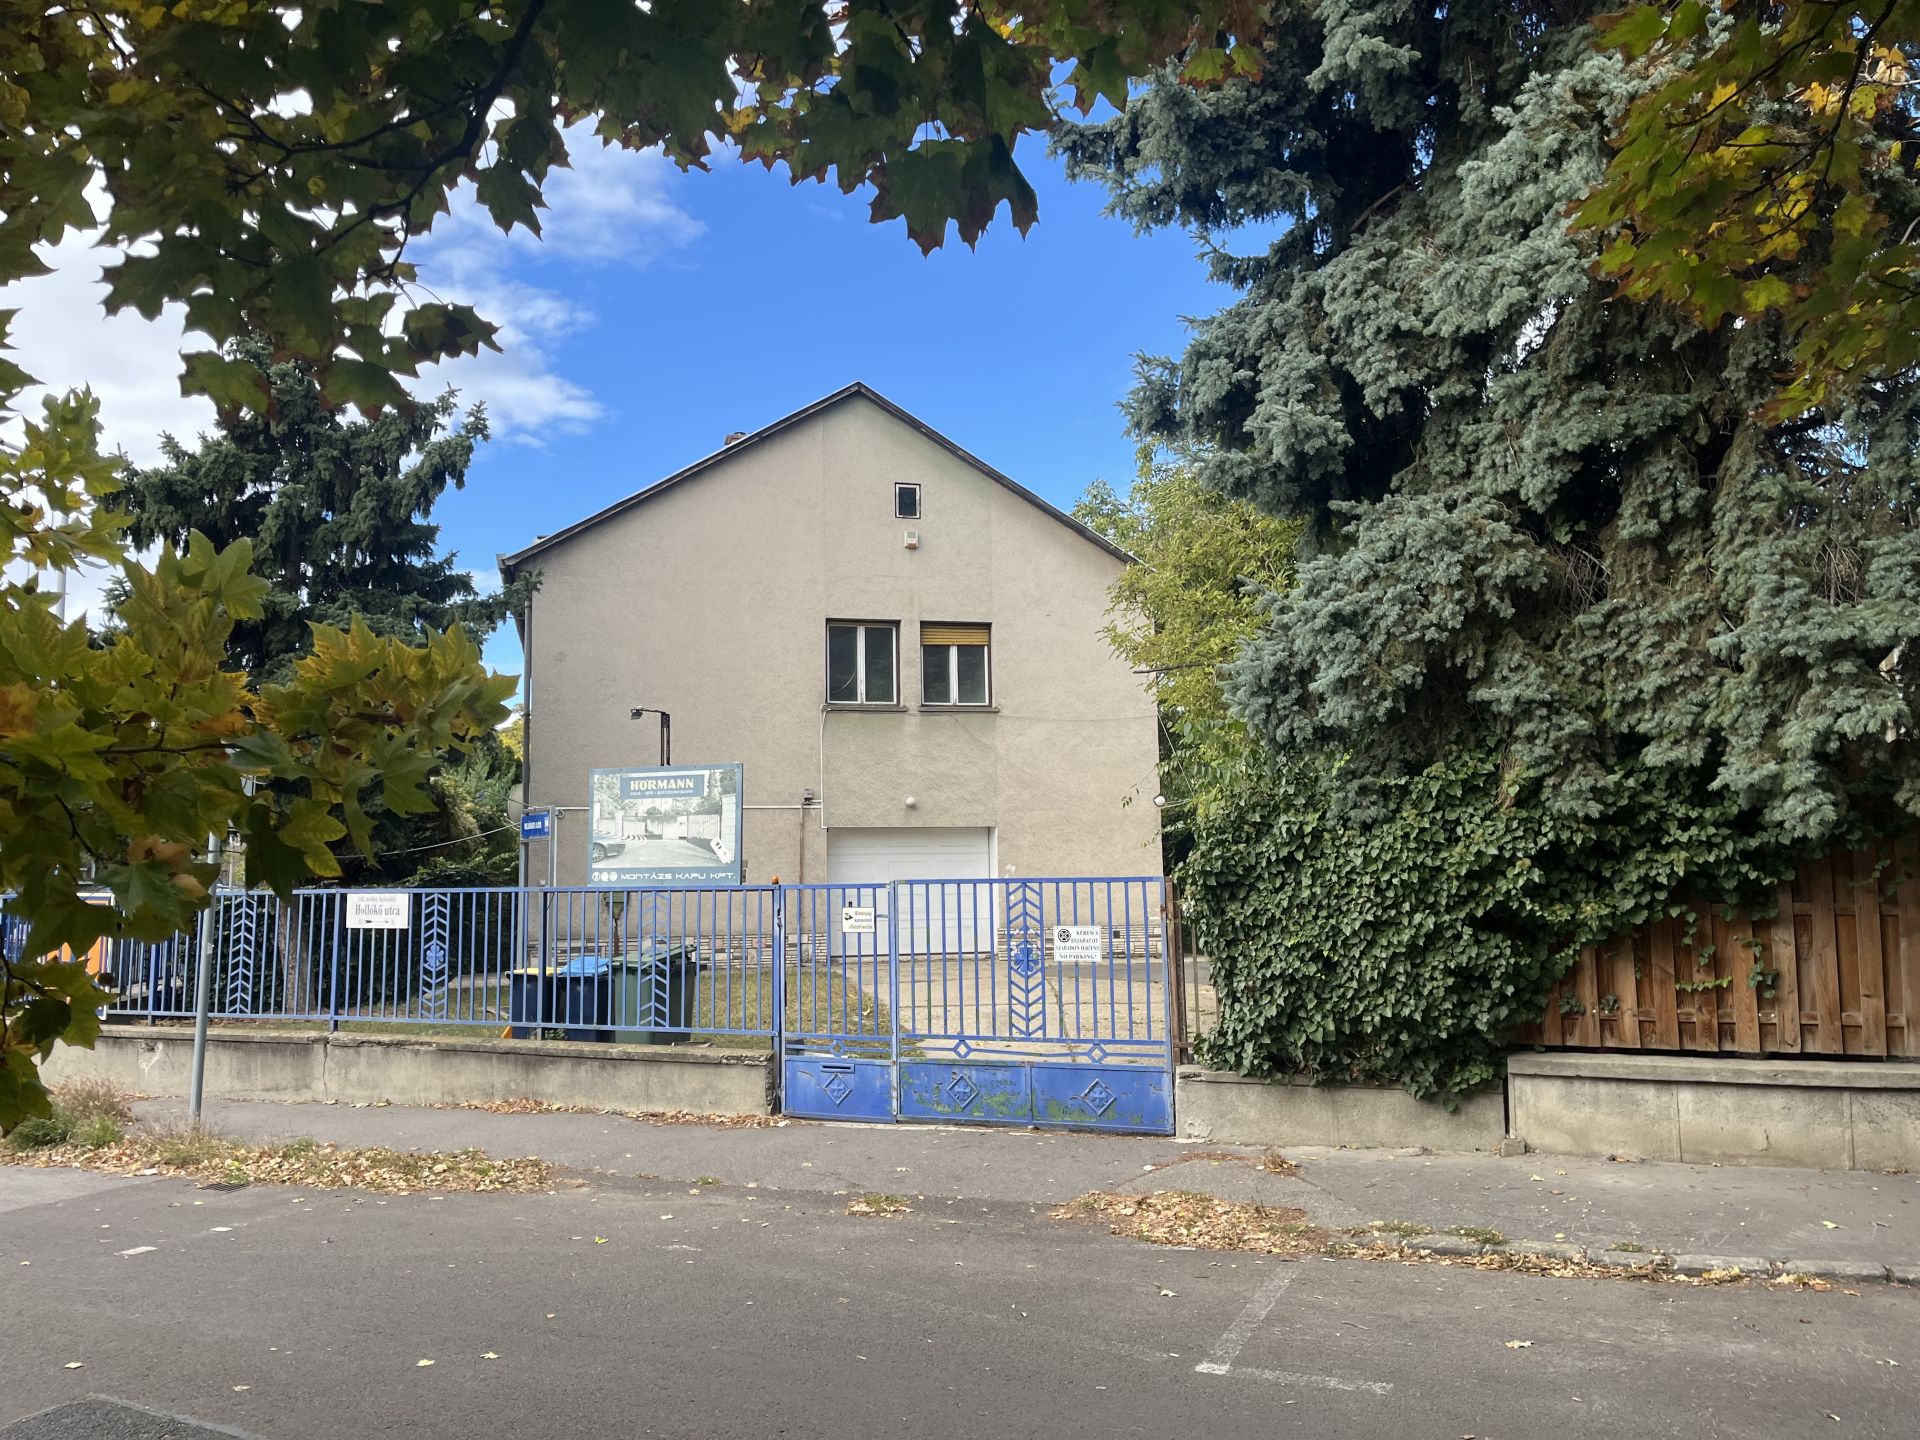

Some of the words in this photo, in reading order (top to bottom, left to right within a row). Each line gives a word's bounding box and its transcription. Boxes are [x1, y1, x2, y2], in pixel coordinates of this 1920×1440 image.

[620, 871, 672, 880] MONTÁZS
[675, 872, 706, 880] KAPU
[710, 871, 736, 879] KFT.
[355, 904, 383, 915] Hollókő
[384, 906, 400, 916] utca
